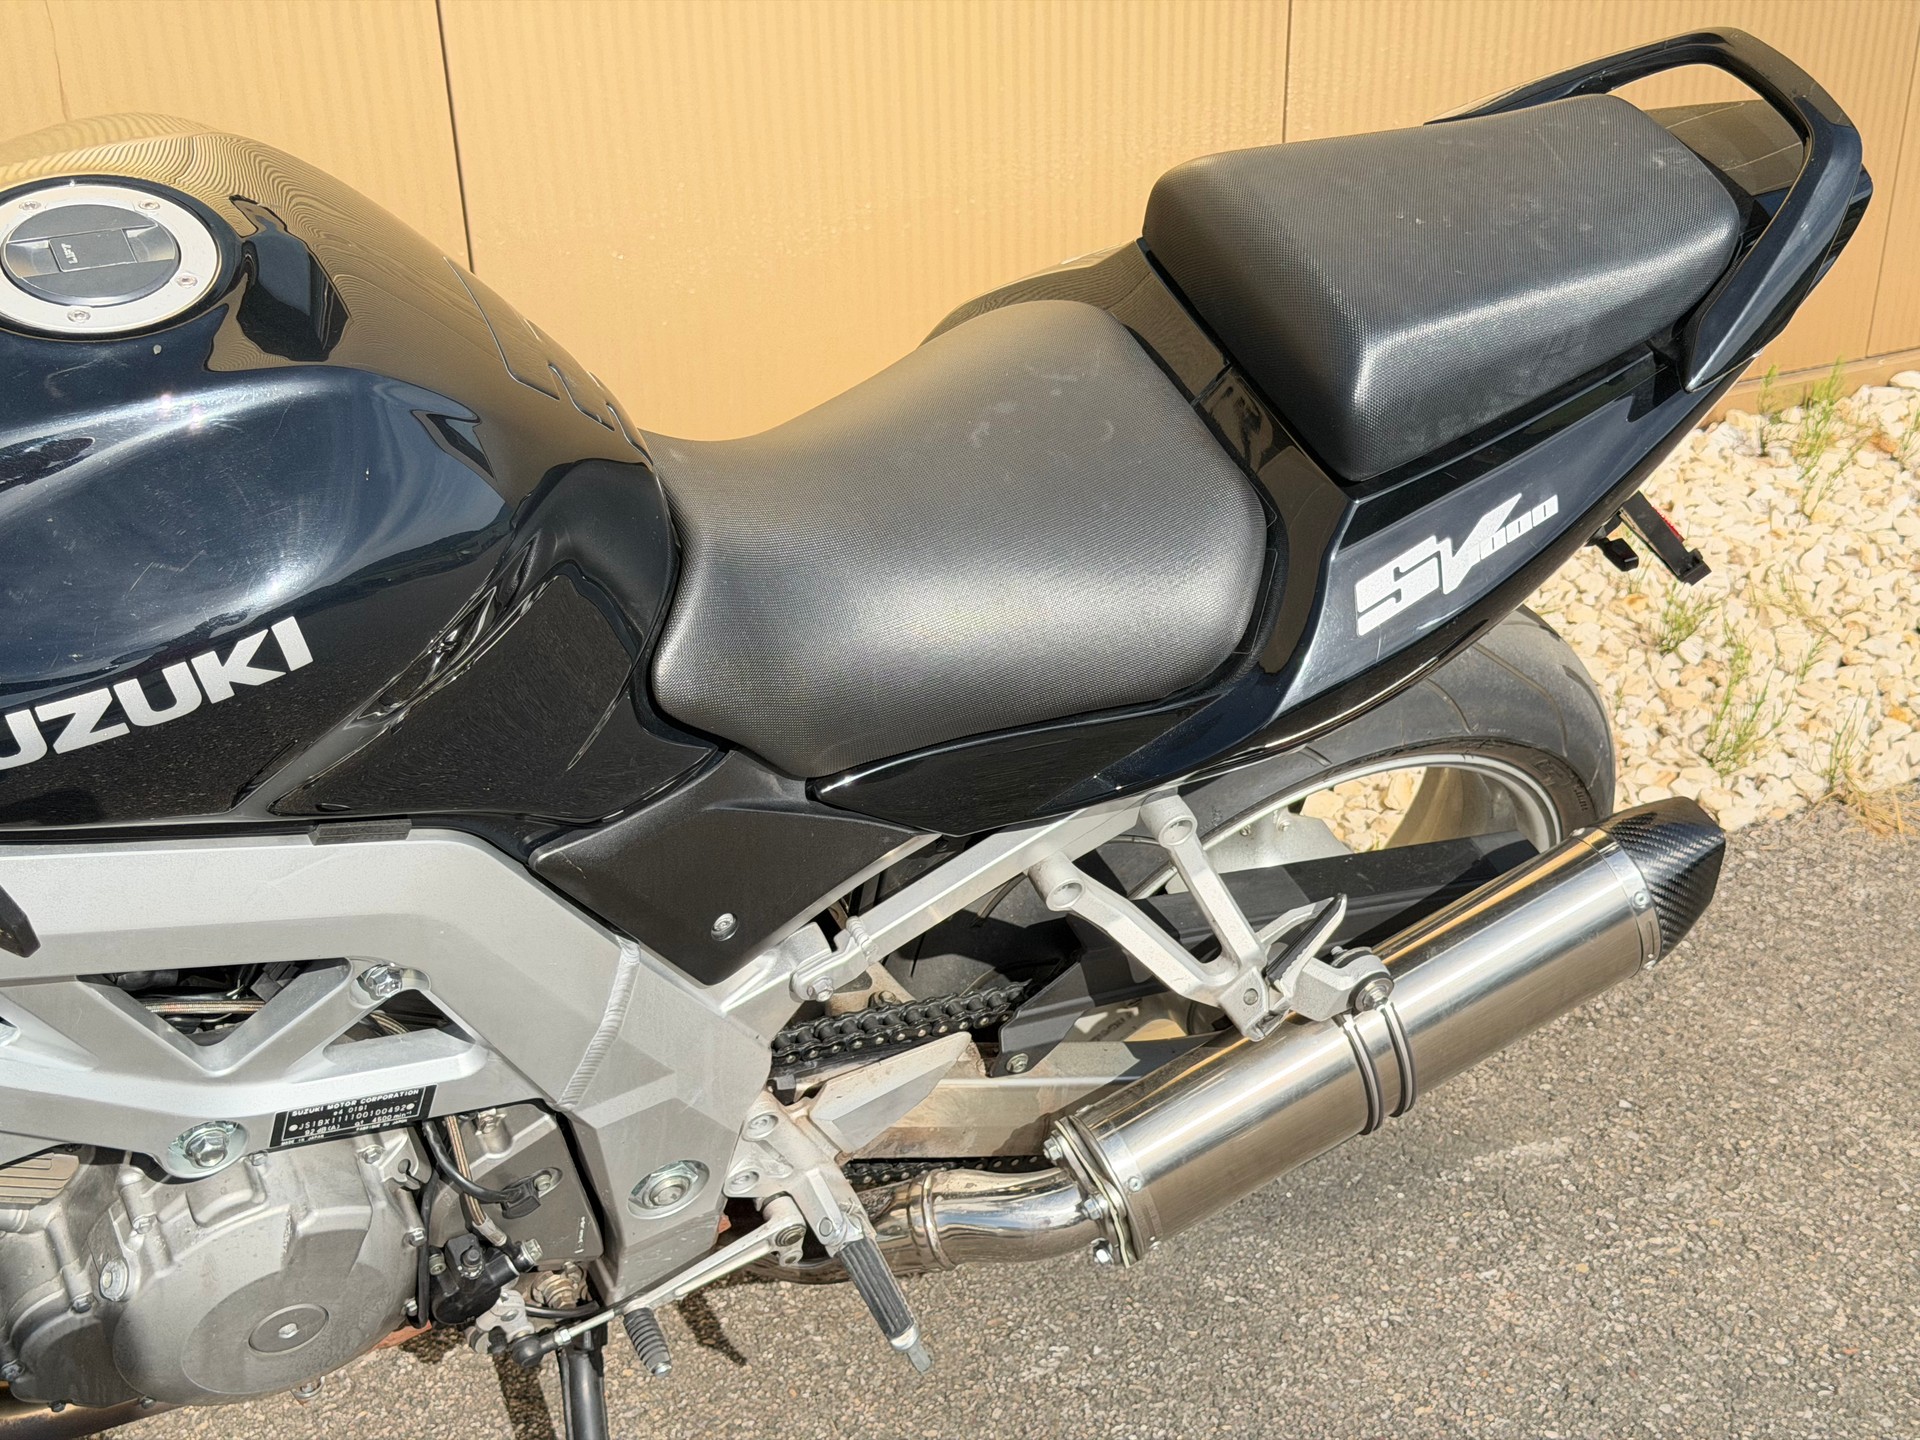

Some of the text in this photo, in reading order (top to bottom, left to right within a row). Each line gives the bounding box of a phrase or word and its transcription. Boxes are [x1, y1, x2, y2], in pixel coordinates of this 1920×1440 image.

[292, 1089, 419, 1117] SUZUKI MOTOR CORPORATION
